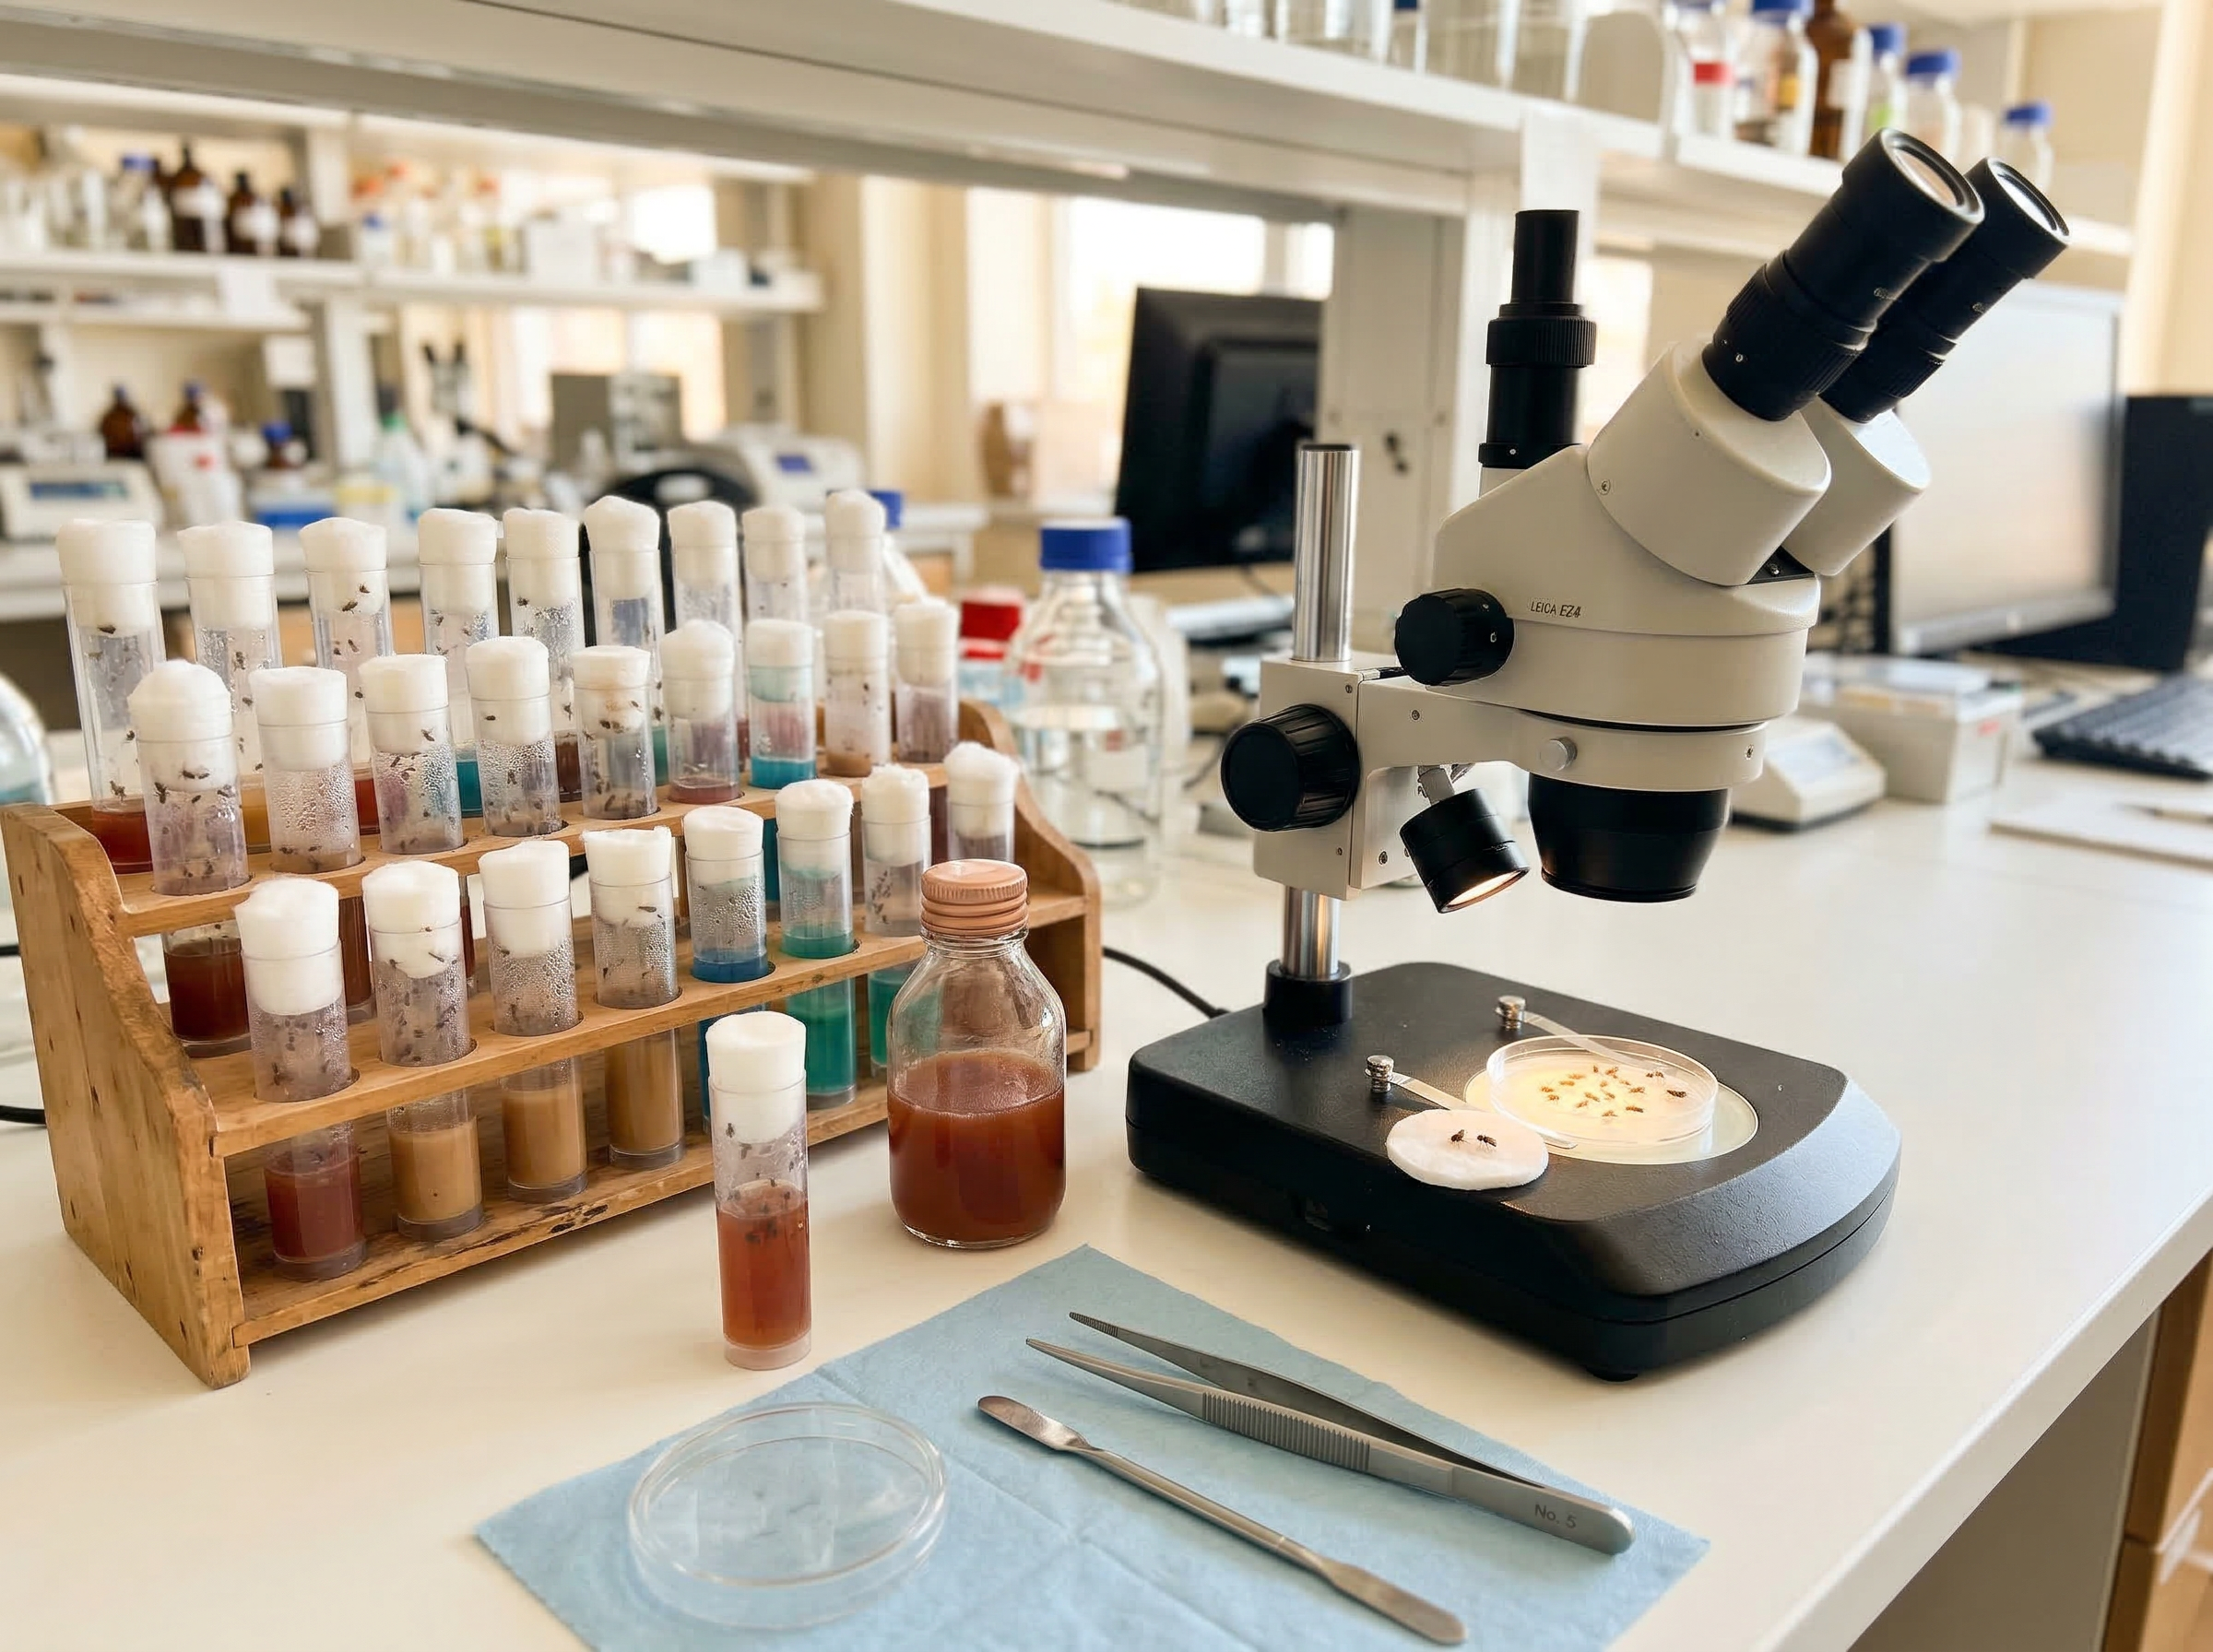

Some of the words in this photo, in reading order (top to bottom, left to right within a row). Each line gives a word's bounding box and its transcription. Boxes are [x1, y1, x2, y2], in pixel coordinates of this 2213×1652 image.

[1531, 601, 1556, 615] LEICA
[1559, 605, 1581, 618] EZ4
[1565, 1515, 1577, 1528] 5
